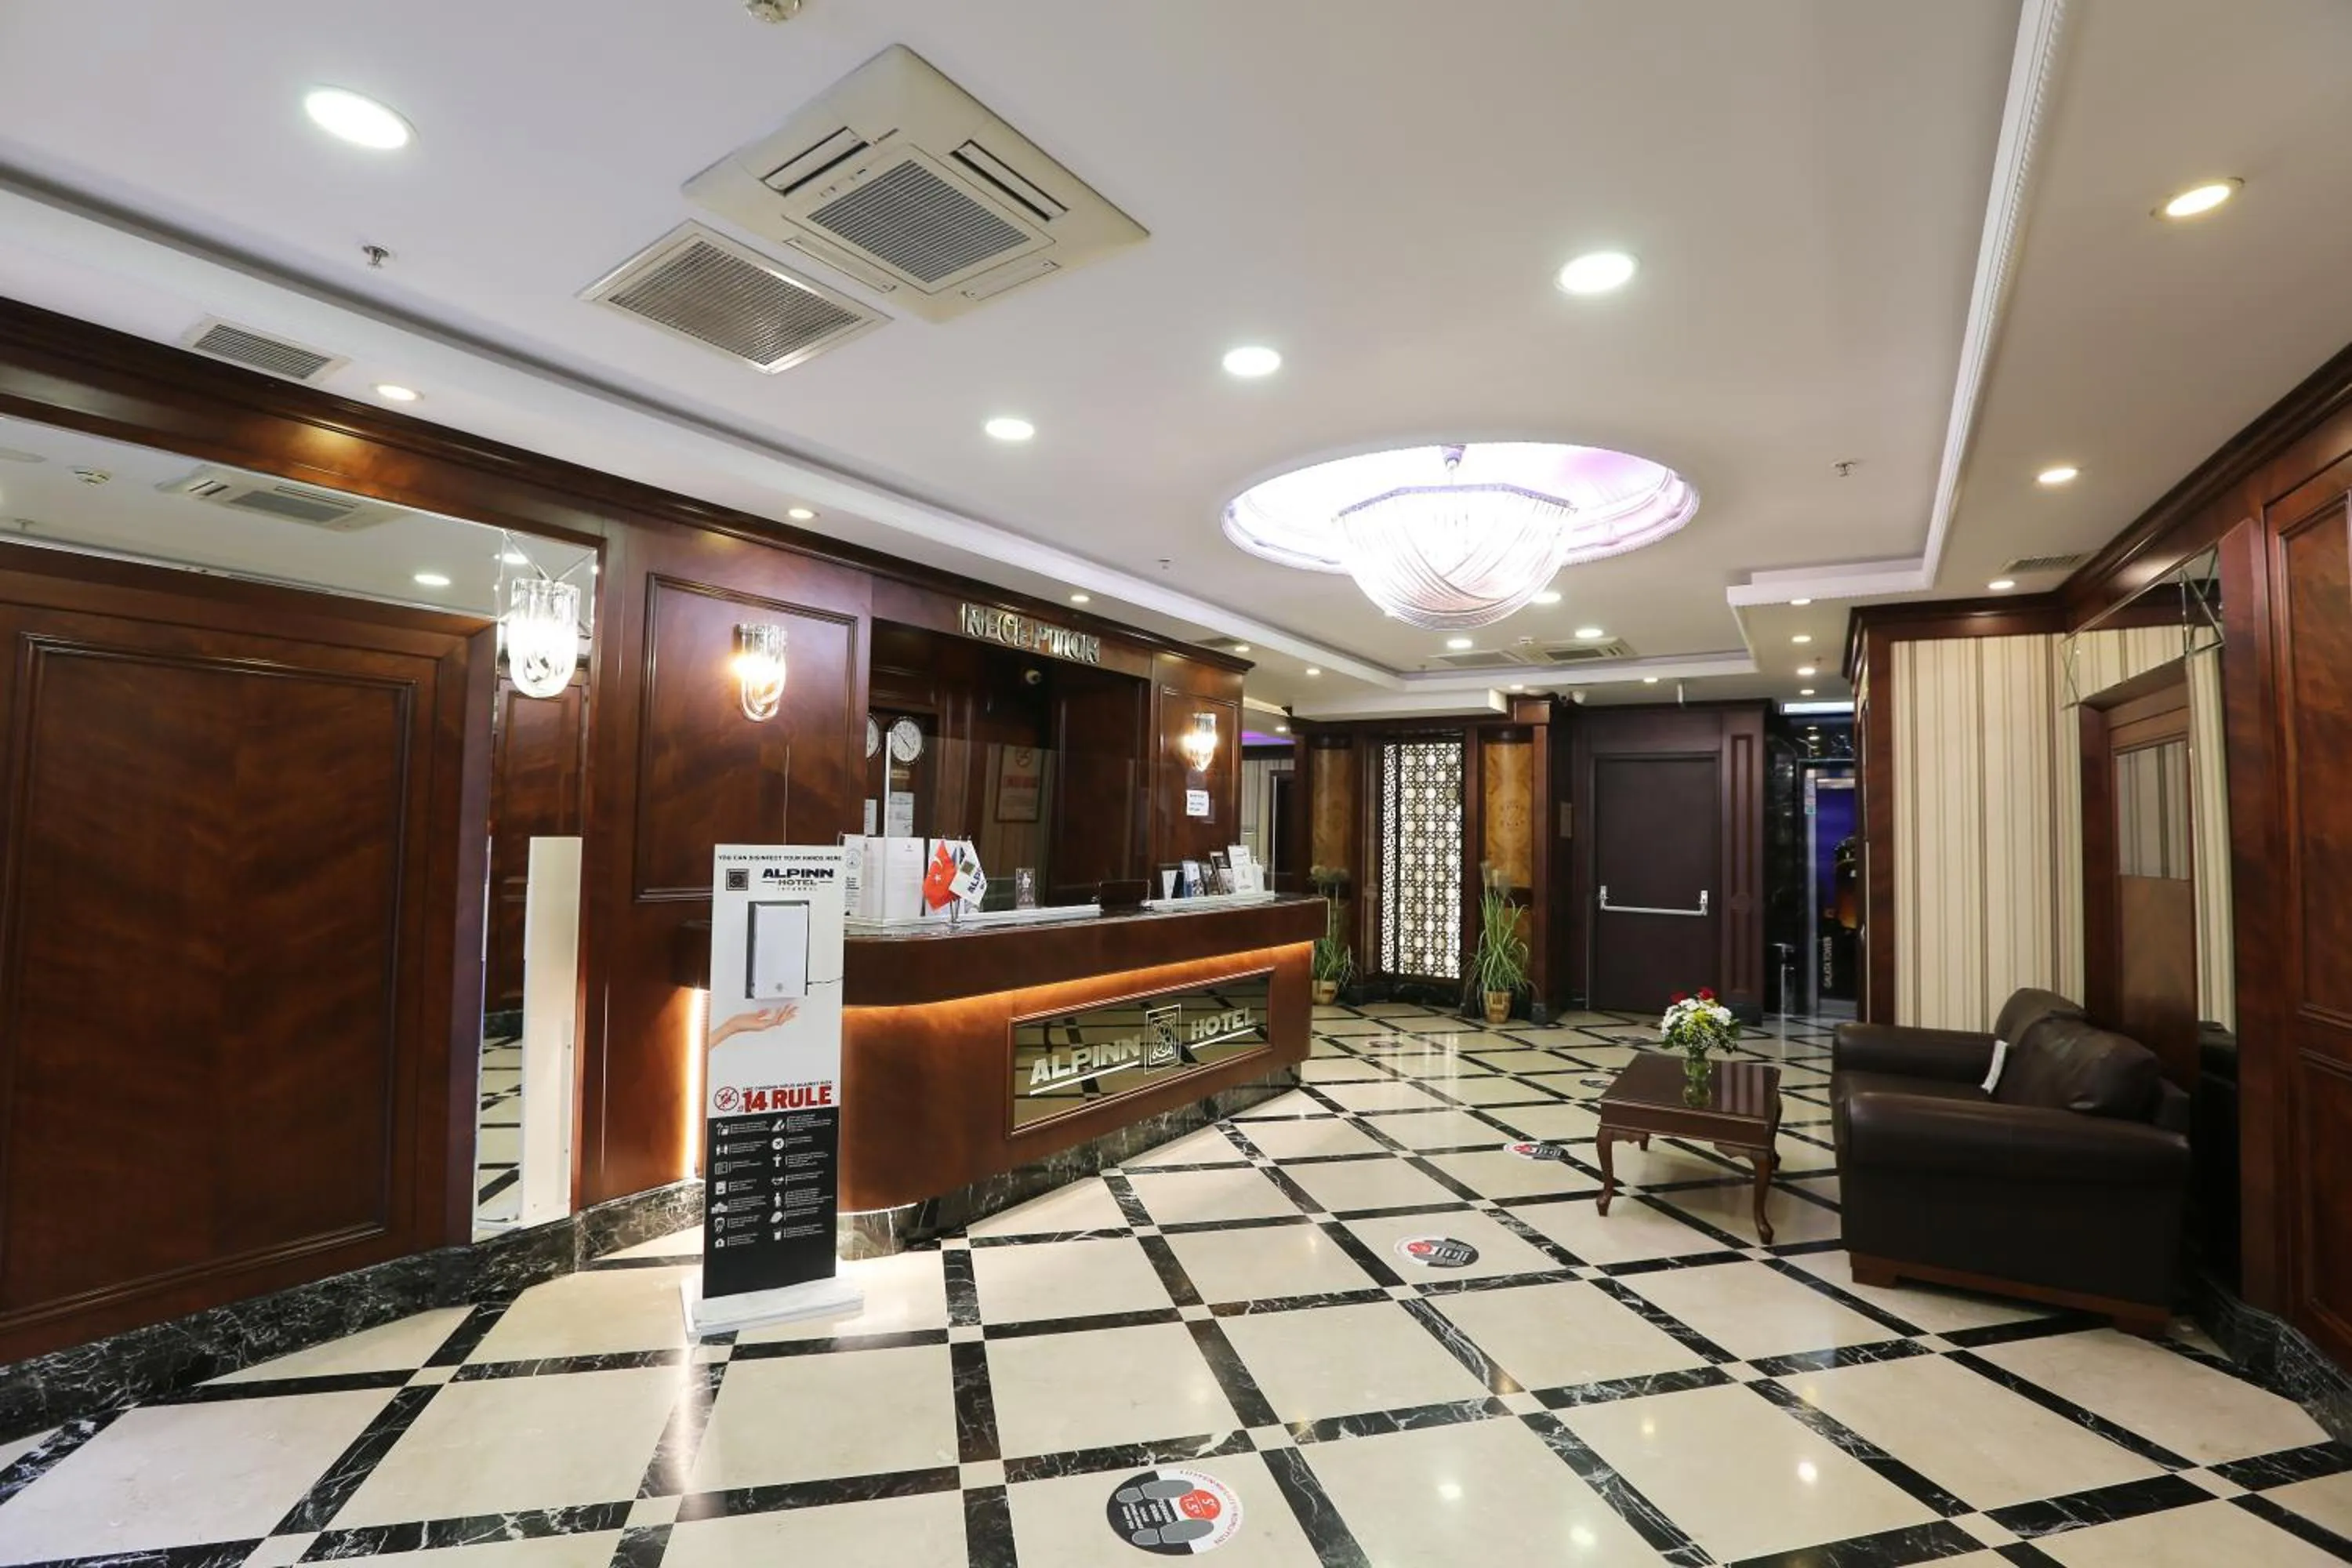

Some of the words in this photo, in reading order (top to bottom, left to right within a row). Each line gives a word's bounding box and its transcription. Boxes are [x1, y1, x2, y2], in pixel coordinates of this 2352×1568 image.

[762, 868, 834, 878] ALPINN
[1029, 1034, 1141, 1086] ALPINN
[1190, 1007, 1257, 1040] HOTEL
[742, 1091, 768, 1112] 14
[771, 1086, 832, 1109] RULE
